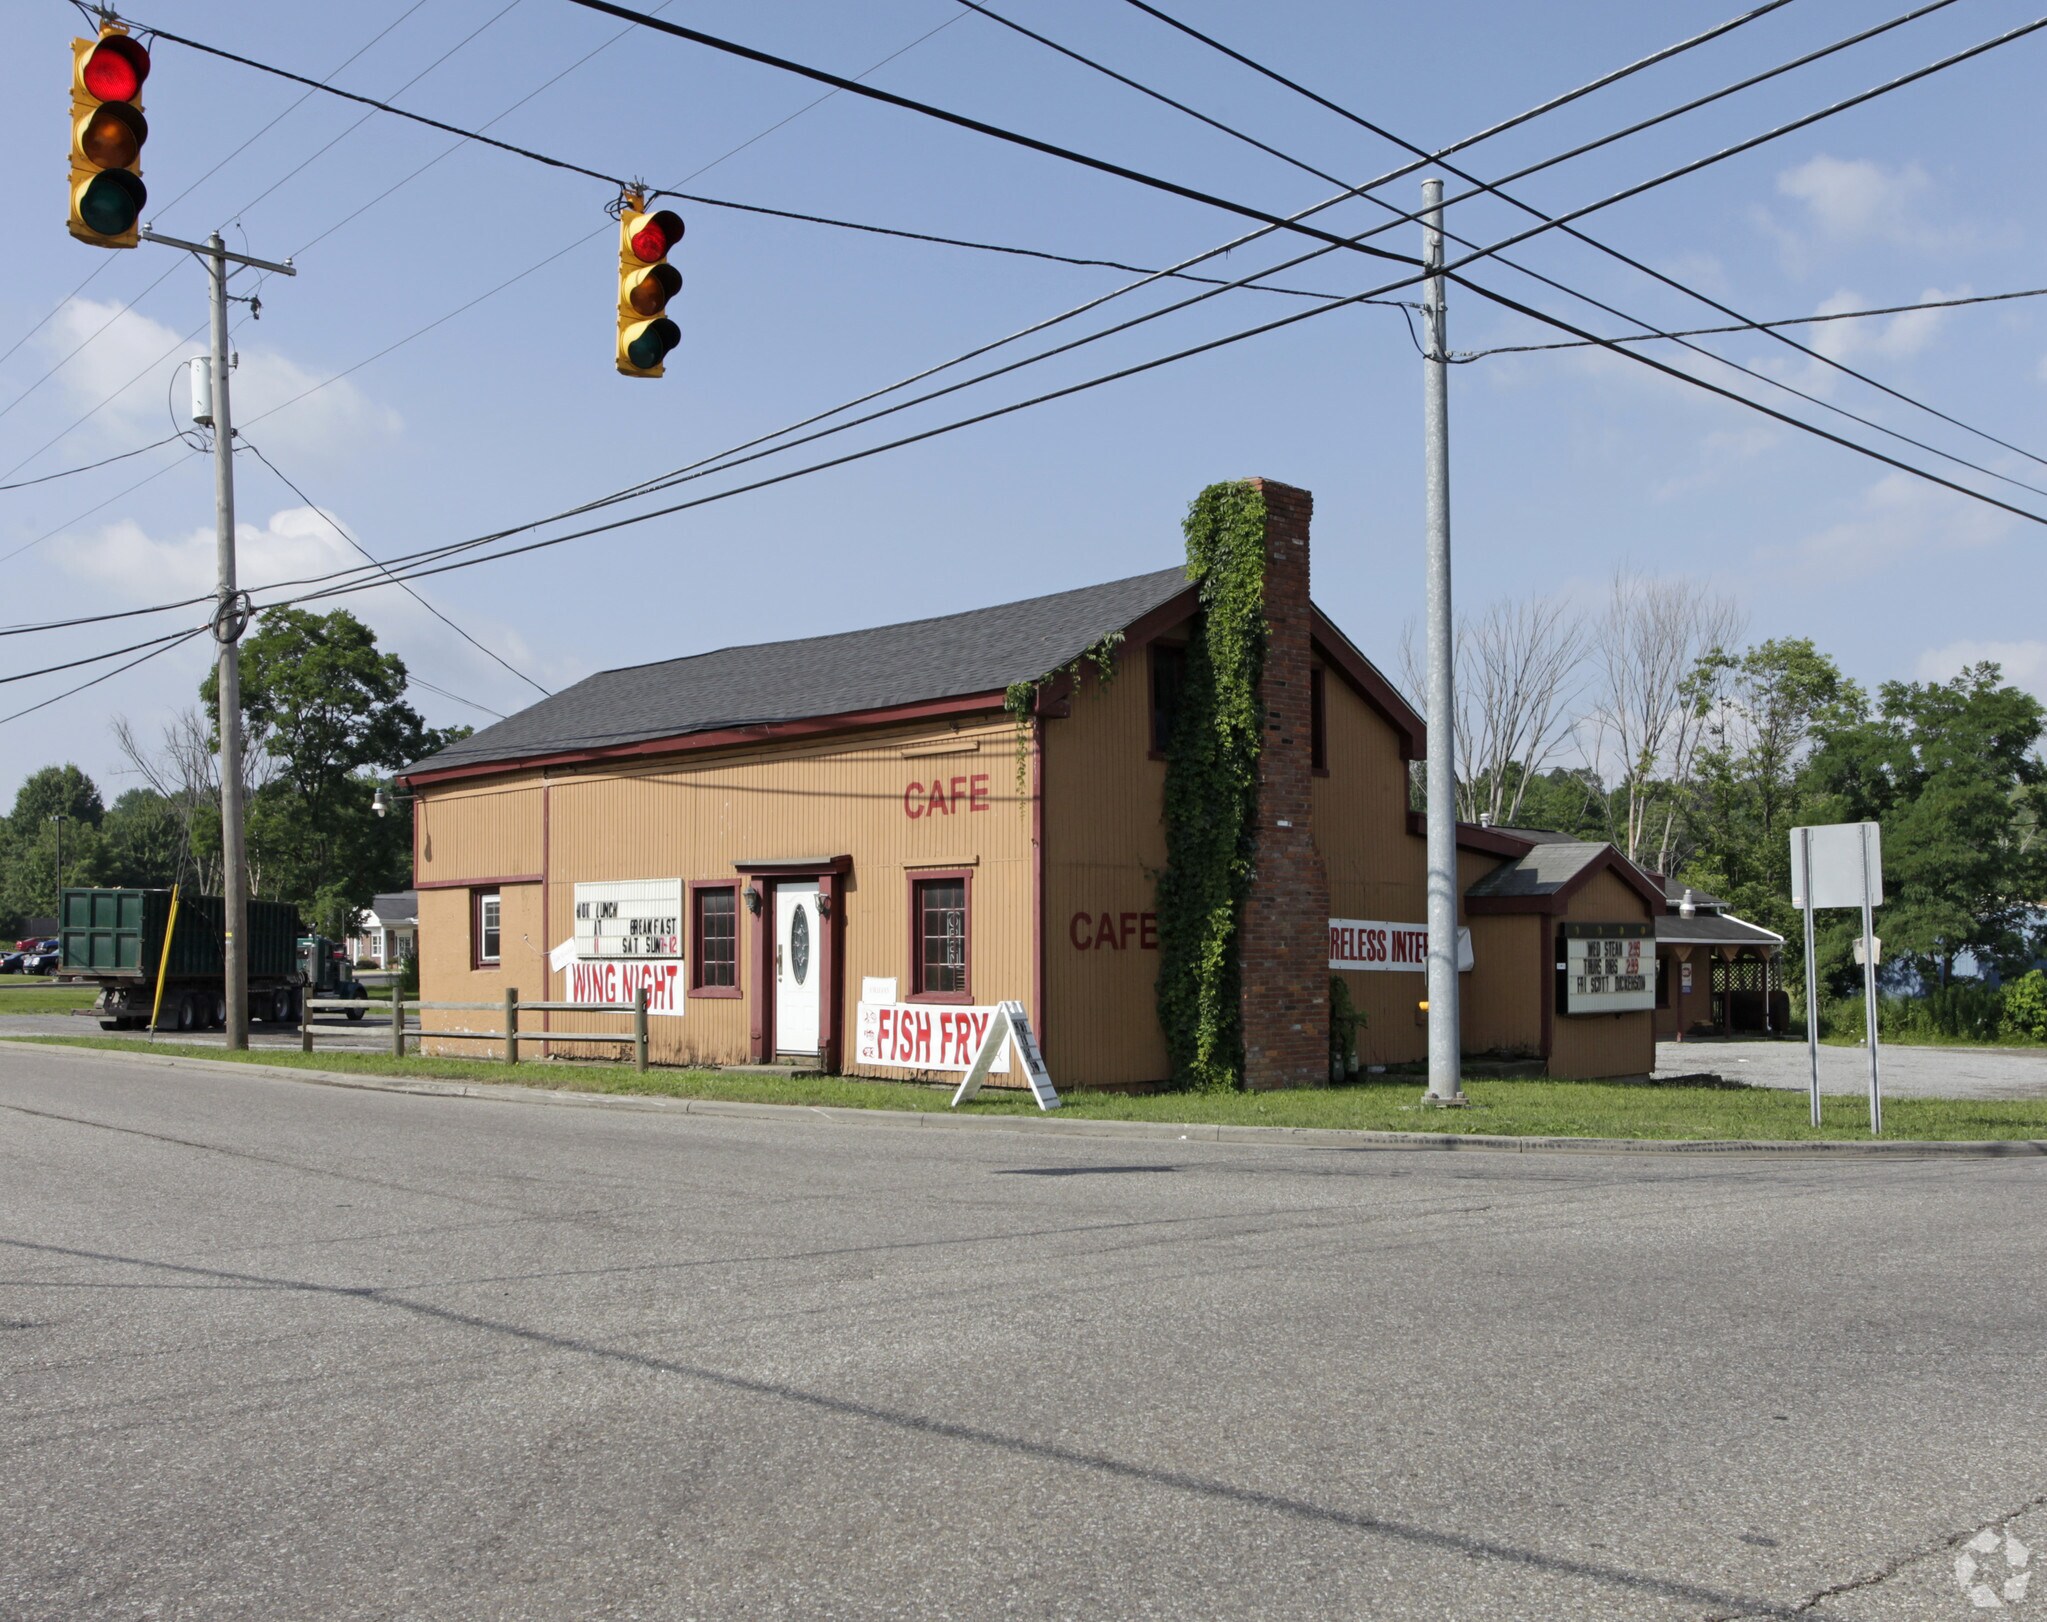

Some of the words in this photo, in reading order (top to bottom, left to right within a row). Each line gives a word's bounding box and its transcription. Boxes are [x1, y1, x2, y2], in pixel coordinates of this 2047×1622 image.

[904, 774, 990, 819] CAFE
[576, 902, 590, 918] HOT
[596, 902, 618, 918] LUNCH
[594, 919, 602, 936] AT
[630, 918, 676, 935] BREAKFAST
[1069, 911, 1159, 950] CAFE
[622, 938, 638, 953] SAT
[1587, 941, 1600, 957] WED
[1604, 941, 1622, 957] STEAK
[1584, 959, 1601, 975] THURS
[572, 963, 615, 1002] WING
[623, 964, 678, 1010] NIGHT
[1577, 976, 1587, 993] FRI
[1591, 976, 1609, 993] SCOTT
[877, 1009, 931, 1063] FISH
[940, 1012, 989, 1065] FRY
